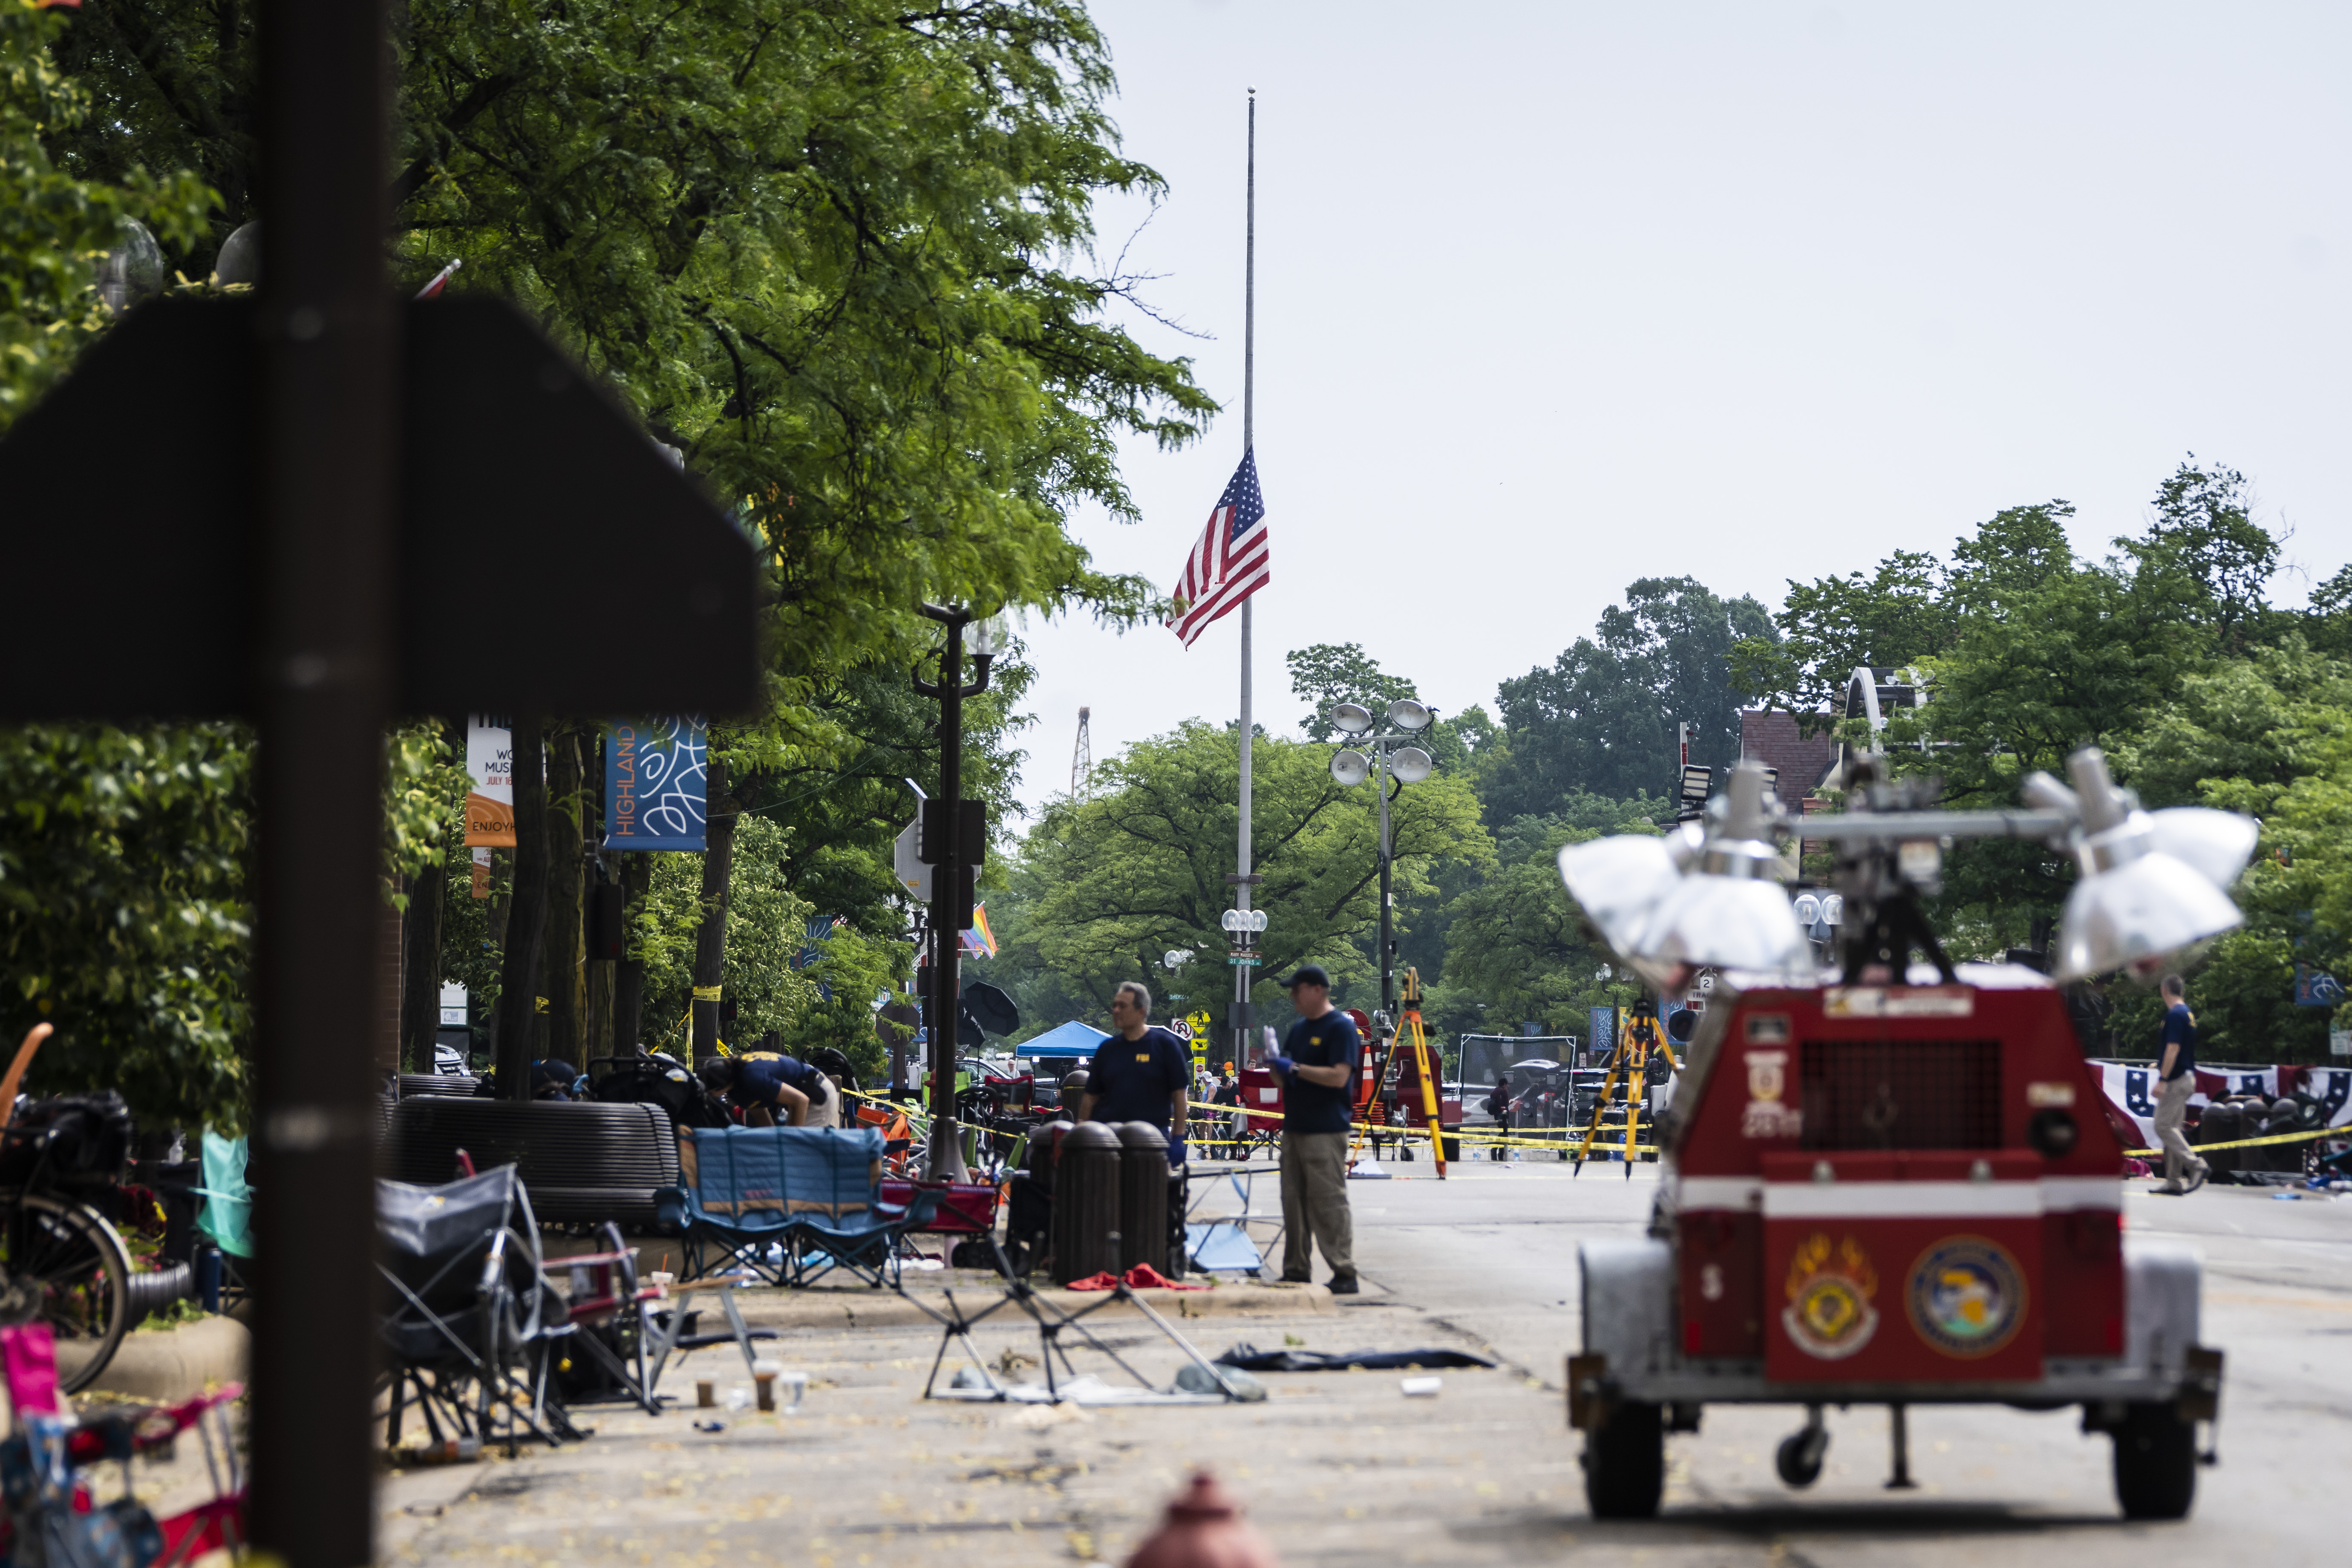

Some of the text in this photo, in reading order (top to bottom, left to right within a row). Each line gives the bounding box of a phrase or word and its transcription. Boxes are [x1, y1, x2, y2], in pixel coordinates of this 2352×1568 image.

[486, 776, 503, 785] JULY
[616, 726, 635, 835] HIGHLAND
[1703, 979, 1710, 988] 2
